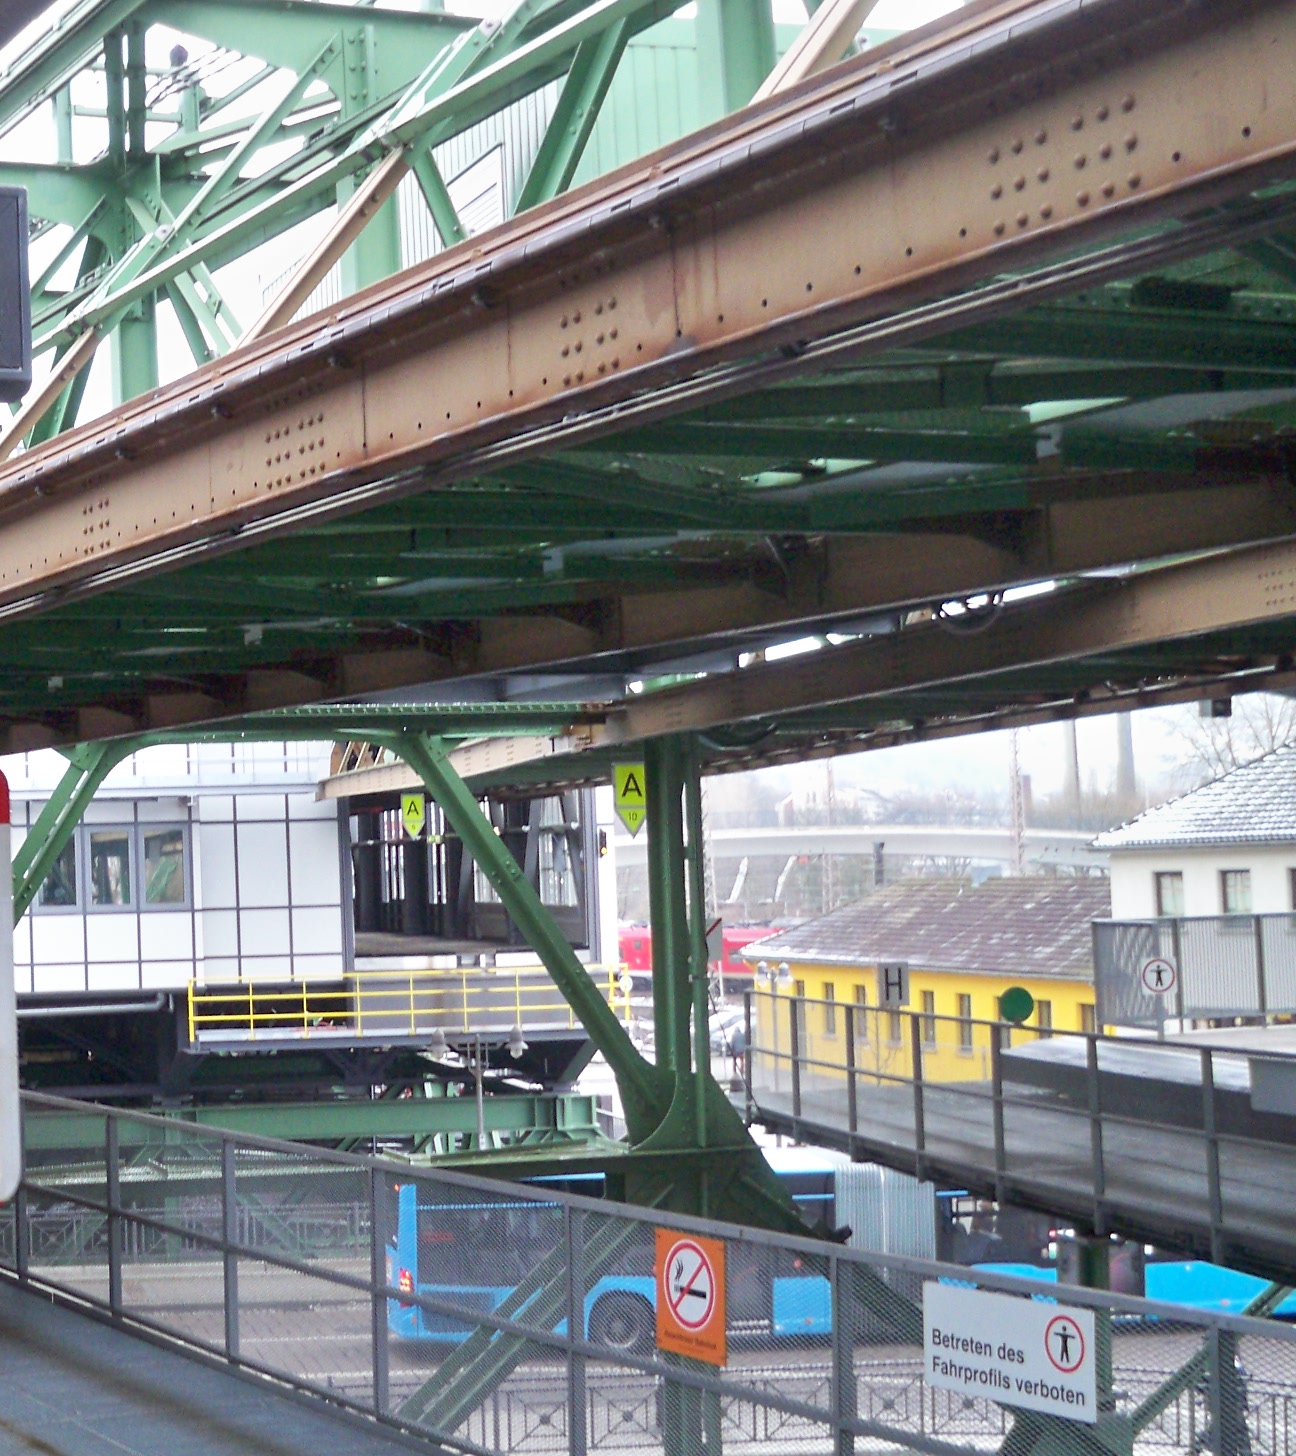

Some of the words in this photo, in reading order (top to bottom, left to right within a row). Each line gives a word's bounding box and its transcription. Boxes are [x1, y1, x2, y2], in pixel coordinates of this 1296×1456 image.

[621, 772, 642, 798] A
[406, 800, 419, 816] A
[885, 967, 902, 1001] H
[932, 1328, 992, 1357] Betreten
[997, 1343, 1024, 1364] des
[932, 1356, 1010, 1389] Fahrprofils
[1015, 1378, 1085, 1406] verboten
